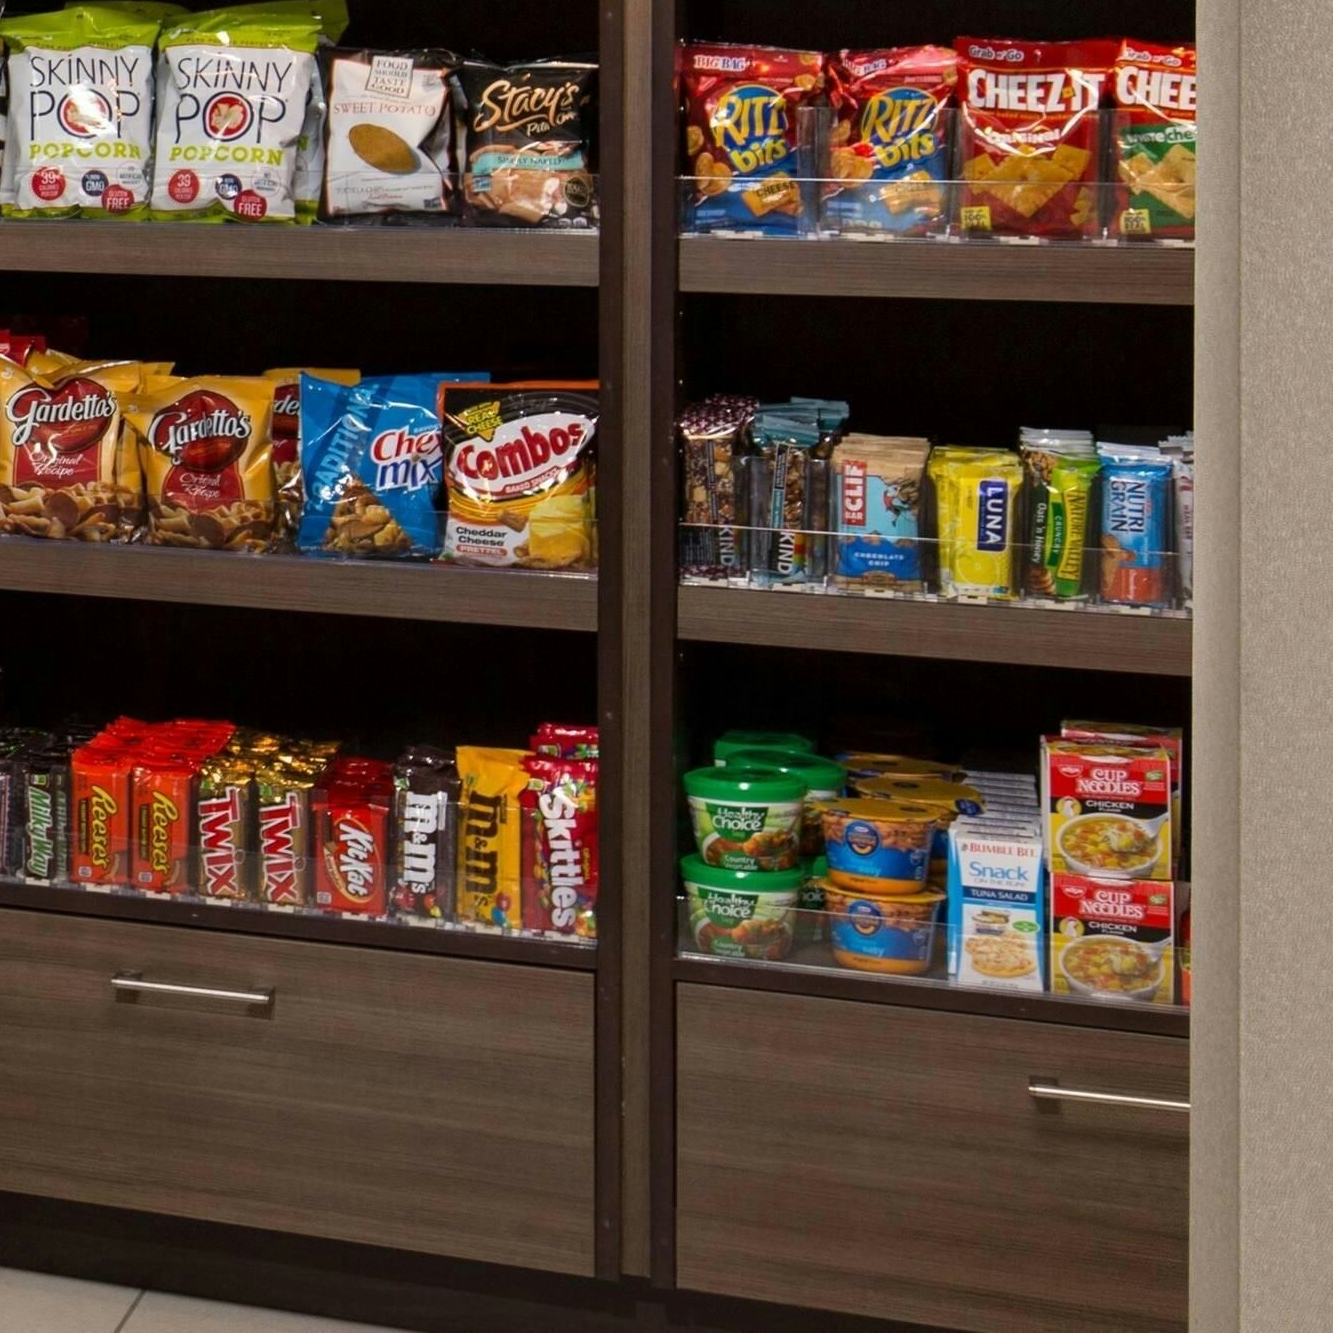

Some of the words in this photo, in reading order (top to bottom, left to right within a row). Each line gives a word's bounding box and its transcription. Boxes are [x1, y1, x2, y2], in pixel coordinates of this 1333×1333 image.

[969, 45, 993, 59] Grab
[1006, 50, 1024, 61] Go
[30, 52, 139, 87] SKINNY
[177, 53, 293, 92] SKINNY
[376, 60, 409, 70] FOOD
[721, 58, 745, 71] BAG
[371, 84, 405, 94] GOOD
[374, 77, 405, 86] TASTE
[333, 102, 375, 114] SWEET
[474, 79, 579, 132] Stacy's
[30, 90, 139, 140] POP
[175, 91, 287, 144] POP
[713, 94, 787, 147] RITZ
[862, 94, 937, 146] RITZ
[29, 142, 141, 160] POPCORN
[169, 146, 284, 166] POPCORN
[731, 139, 787, 172] bits
[875, 133, 936, 167] bits
[177, 174, 191, 187] 39
[756, 180, 795, 197] CHEESE
[106, 198, 130, 210] FREE
[238, 202, 262, 216] FREE
[6, 387, 117, 446] Gardetto's
[466, 416, 504, 434] CHEESE
[456, 422, 584, 480] Combos
[845, 465, 865, 511] CLIF
[1036, 502, 1047, 523] Oats
[1066, 492, 1086, 536] NATURE
[1110, 480, 1128, 532] GRAIN
[1129, 481, 1146, 533] NUTRI
[986, 487, 1005, 545] LUNA
[456, 526, 507, 540] Cheddar
[458, 535, 505, 547] Cheese
[460, 545, 505, 556] PRETZEL
[718, 526, 734, 566] KIND
[777, 531, 795, 575] KIND
[1032, 535, 1044, 564] Honey
[855, 551, 904, 561] CHOCOLATE
[868, 559, 890, 567] CHIP
[1091, 768, 1127, 782] CUP
[1076, 778, 1141, 796] NOODLES
[717, 805, 765, 821] Healthy
[1085, 799, 1135, 810] CHICKEN
[92, 785, 117, 867] Reese's
[152, 791, 179, 873] Reese's
[712, 816, 762, 832] Choice
[969, 842, 1013, 855] BUMBLE
[539, 792, 584, 928] Skittles
[724, 854, 755, 866] Country
[969, 861, 1029, 881] Snack
[970, 888, 996, 898] TUNA
[998, 890, 1029, 901] SALAD
[1095, 890, 1131, 904] CUP
[703, 901, 751, 918] Choice
[1081, 899, 1145, 918] NOODLES
[1089, 920, 1138, 933] CHICKEN
